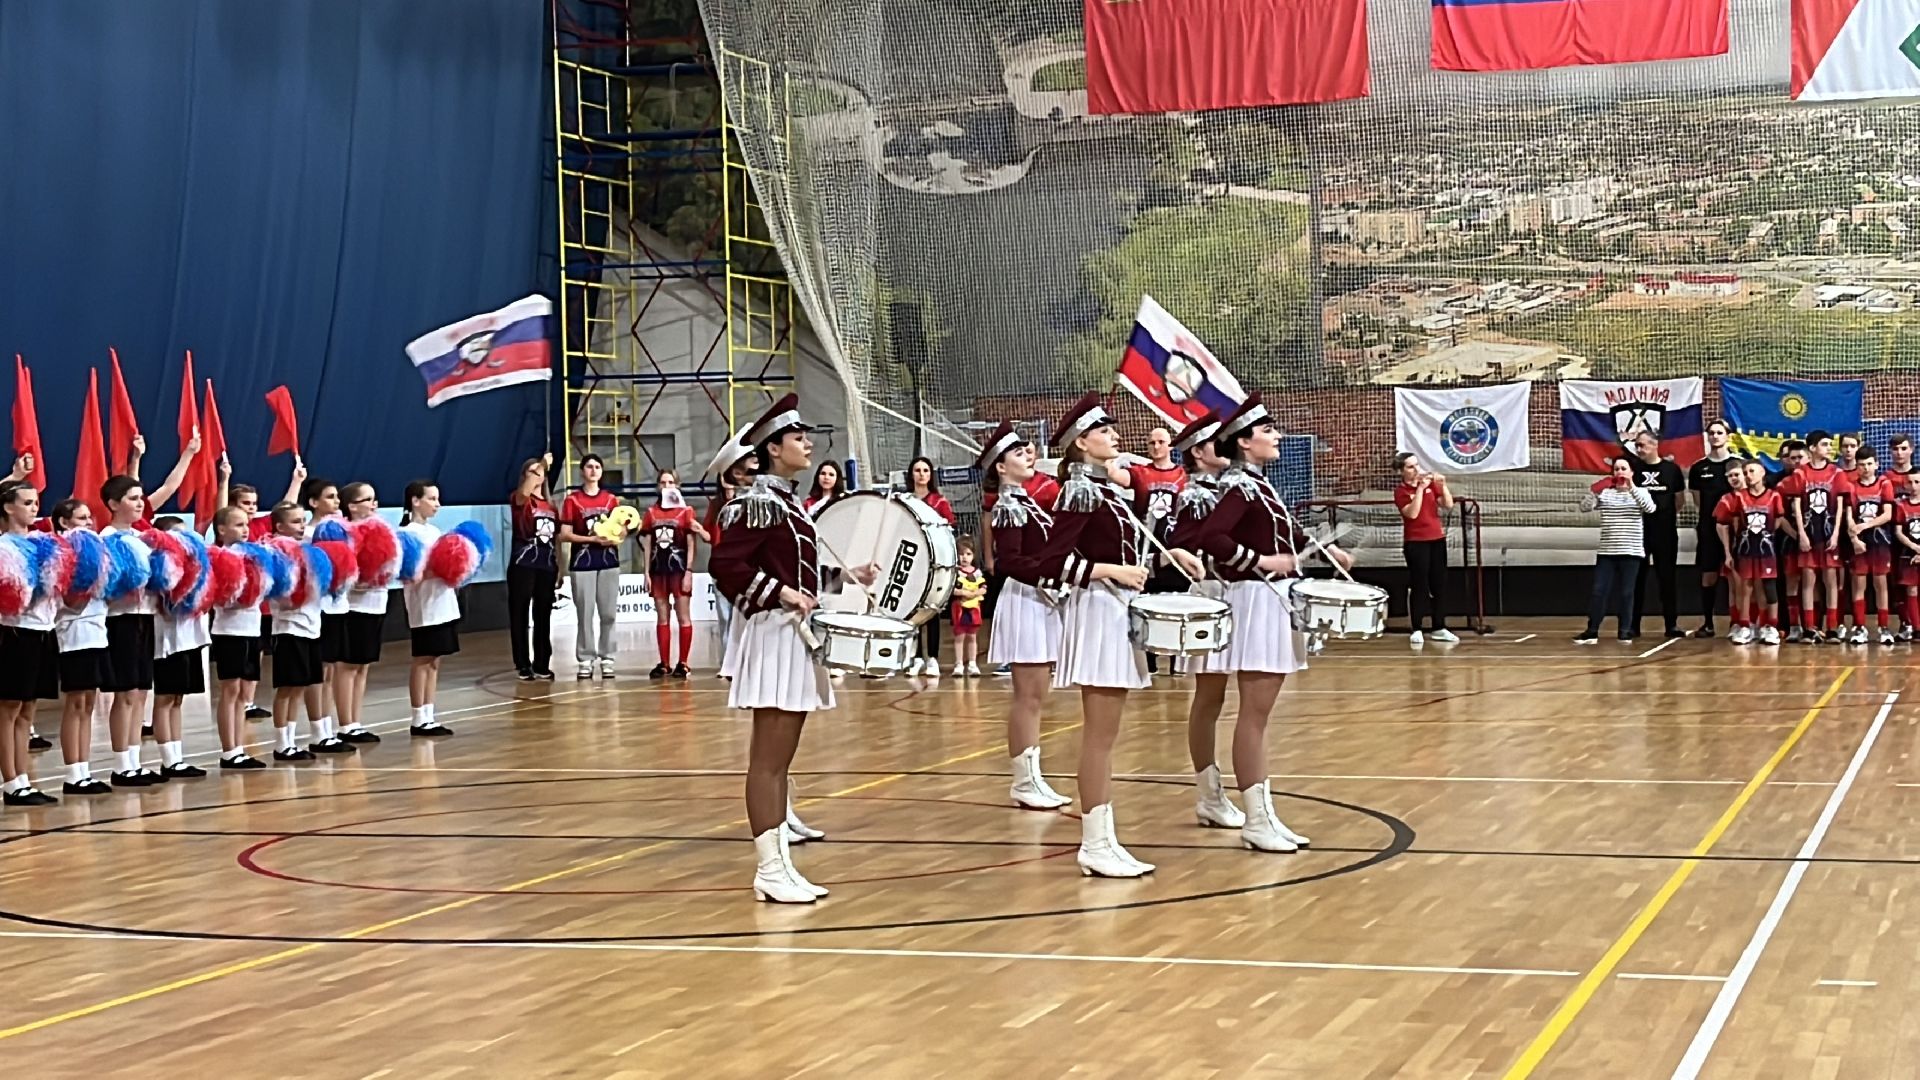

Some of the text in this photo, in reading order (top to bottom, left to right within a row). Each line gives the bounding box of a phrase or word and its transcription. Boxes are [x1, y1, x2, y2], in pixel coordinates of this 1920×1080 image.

[1604, 386, 1670, 405] МОЛНИЯ
[883, 539, 919, 612] peace
[632, 603, 657, 613] 010-
